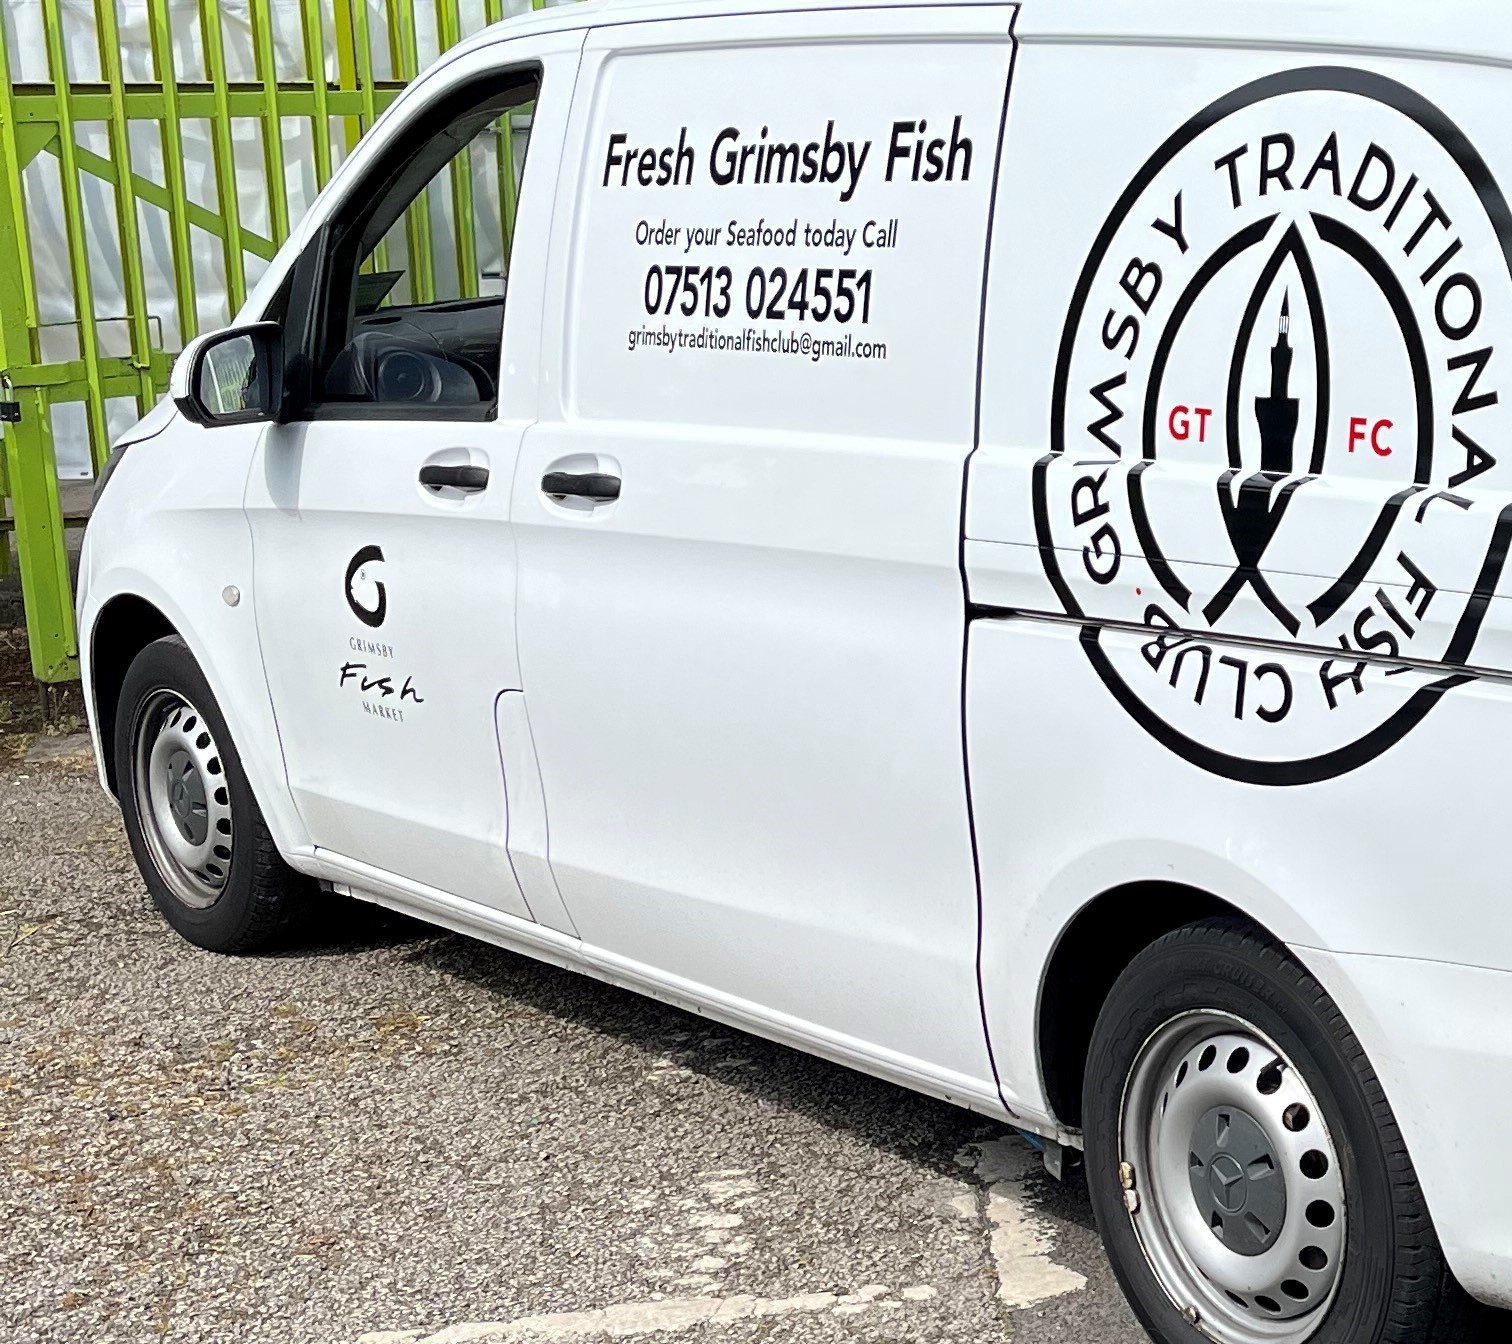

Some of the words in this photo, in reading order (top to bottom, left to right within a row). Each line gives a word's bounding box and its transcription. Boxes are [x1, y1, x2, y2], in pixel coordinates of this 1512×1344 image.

[602, 126, 695, 187] Fresh
[709, 119, 873, 203] Grimsby
[884, 114, 973, 183] Fish
[635, 218, 682, 246] Order
[683, 227, 722, 254] your
[726, 218, 798, 247] Seafood
[803, 218, 857, 257] today
[862, 218, 899, 249] Call
[644, 264, 733, 319] 07513
[745, 265, 873, 325] 024551
[628, 324, 888, 363] grimsbytraditionalfishclub@gmail.com
[1213, 129, 1499, 524] TRADITIONAL
[1071, 189, 1190, 585] GRIMSBY
[1167, 403, 1214, 445] GT
[1347, 416, 1394, 458] FC
[349, 636, 394, 659] GRIMSBY
[1319, 550, 1438, 710] FISH
[1140, 603, 1293, 723] CLUB
[361, 700, 405, 723] MARKET
